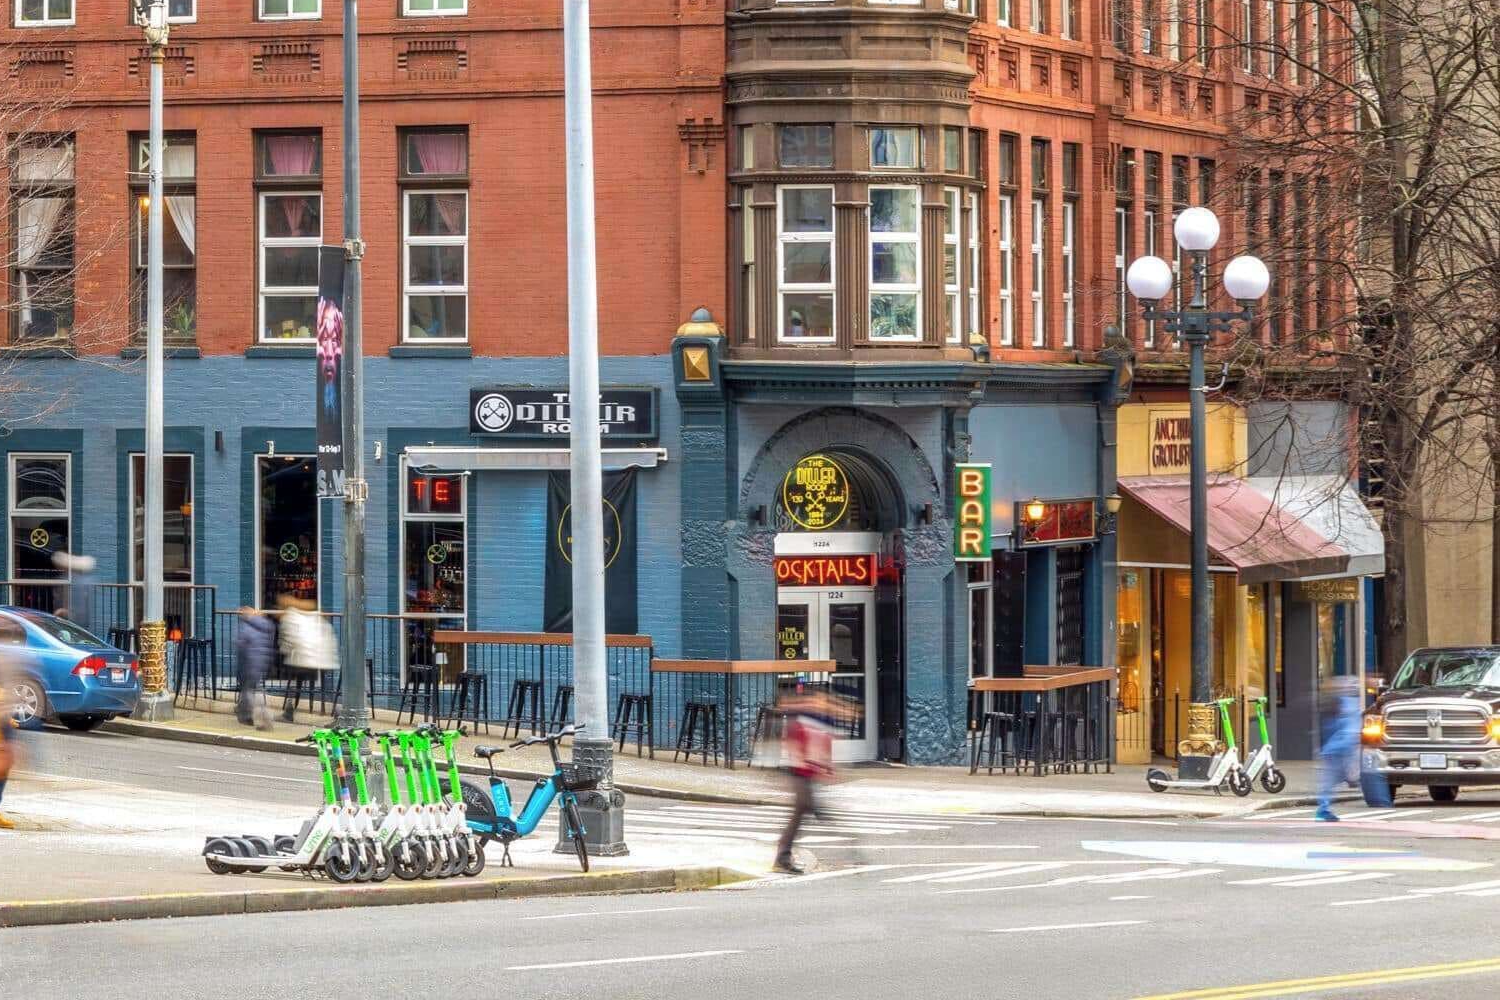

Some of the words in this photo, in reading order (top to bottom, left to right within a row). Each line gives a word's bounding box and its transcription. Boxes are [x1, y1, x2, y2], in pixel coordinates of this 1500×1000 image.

[543, 424, 609, 434] ROM
[959, 470, 984, 555] BAR
[776, 558, 867, 585] OCKTAILS
